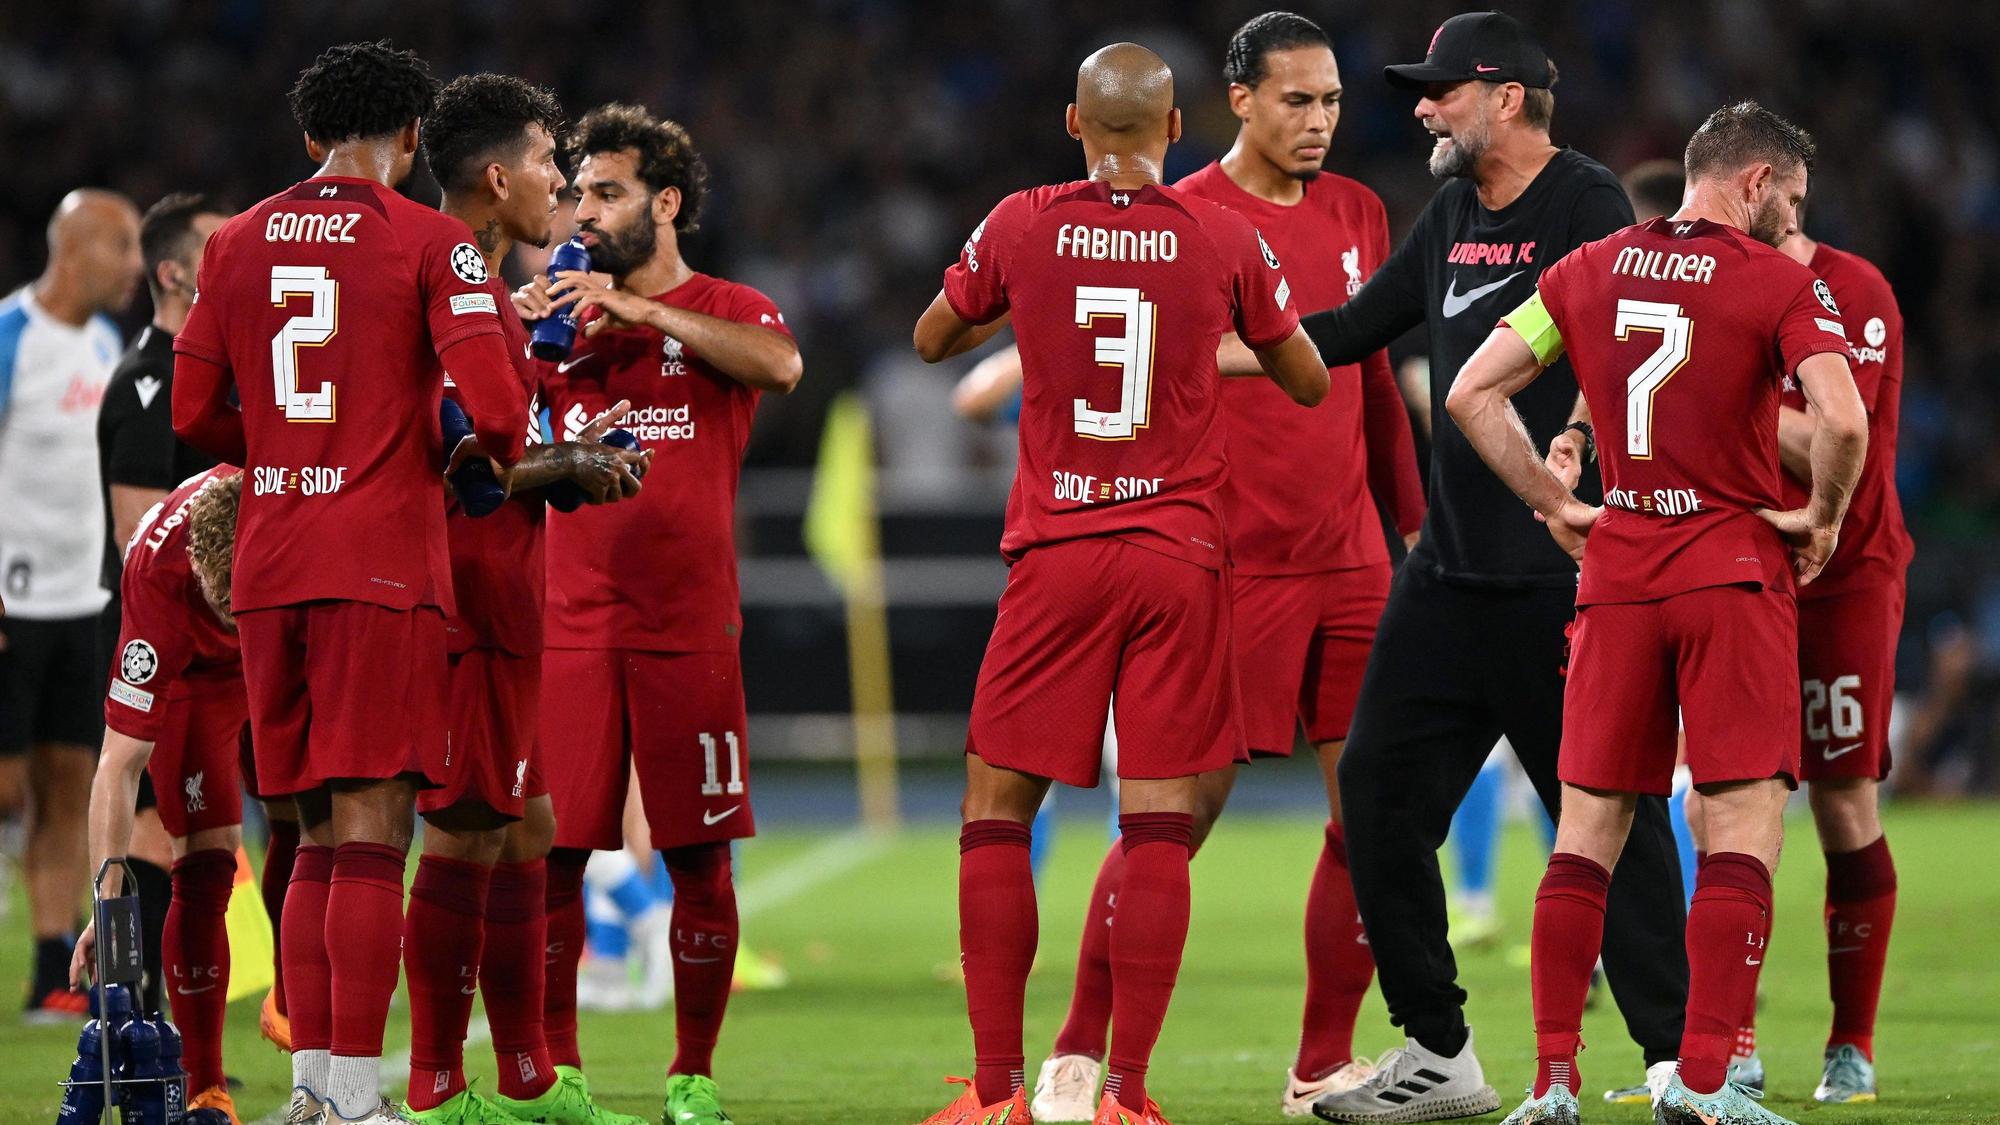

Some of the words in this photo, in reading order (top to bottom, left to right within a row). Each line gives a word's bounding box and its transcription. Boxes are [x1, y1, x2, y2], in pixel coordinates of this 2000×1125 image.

[264, 211, 361, 243] GOMEZ
[1056, 223, 1178, 262] FABINHO
[1515, 241, 1537, 264] FC
[1612, 246, 1717, 285] MILNER
[271, 266, 339, 423] 2
[1074, 286, 1158, 441] 3
[1614, 299, 1695, 460] 7
[1053, 471, 1097, 503] SIDE
[1653, 489, 1706, 516] SIDE
[1803, 674, 1865, 742] 26
[698, 731, 745, 795] 11
